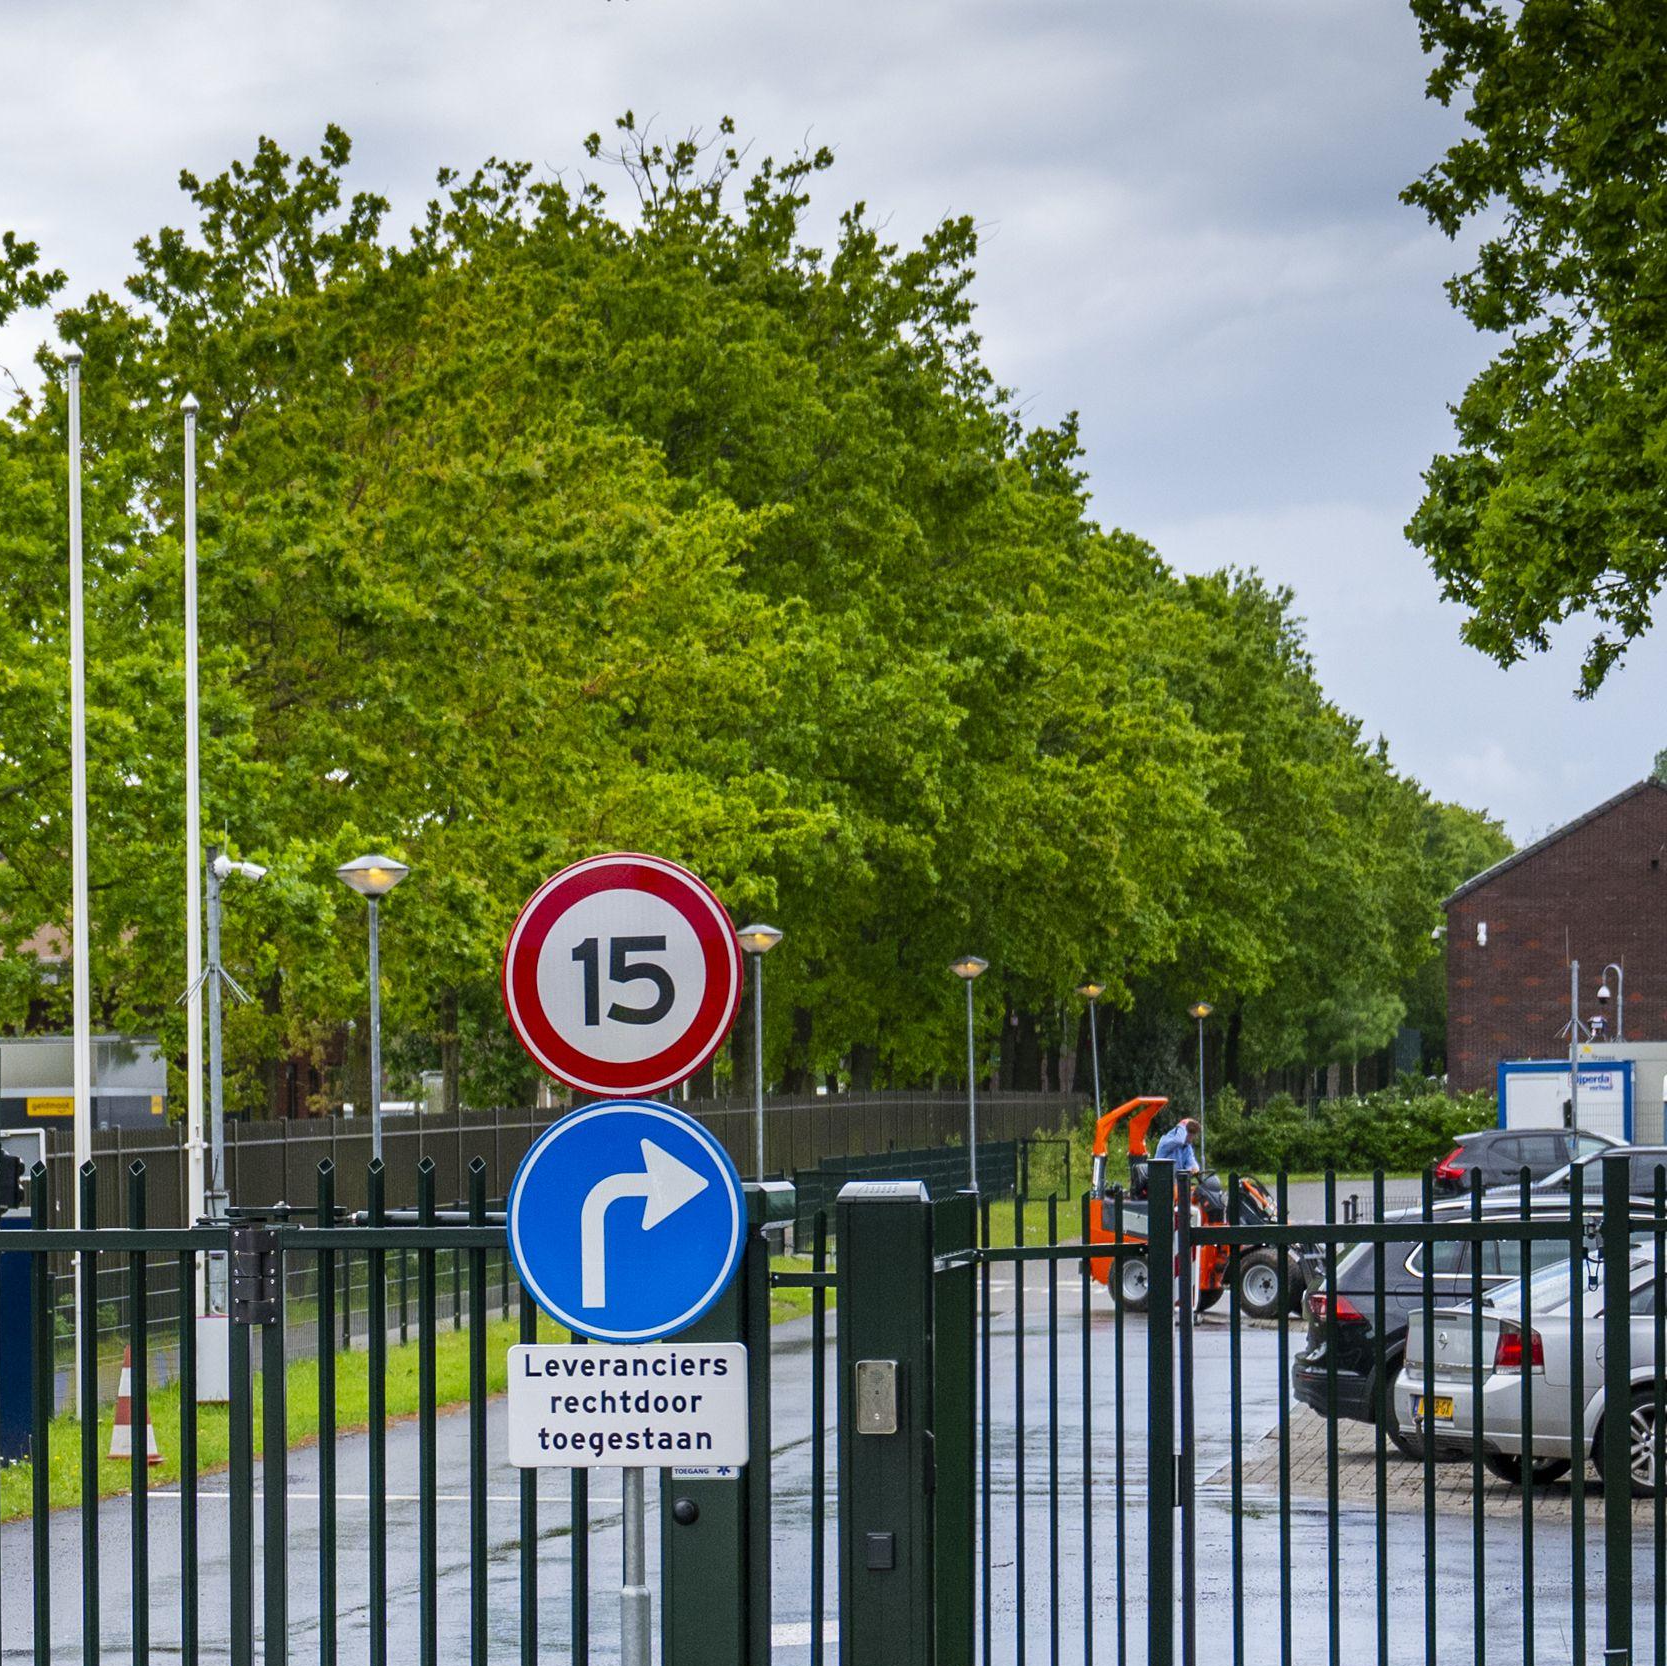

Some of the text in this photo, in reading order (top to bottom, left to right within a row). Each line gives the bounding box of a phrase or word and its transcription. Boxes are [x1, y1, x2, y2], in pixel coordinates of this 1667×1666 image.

[571, 934, 676, 1026] 15
[525, 1353, 728, 1377] Leveranciers
[550, 1389, 703, 1414] rechtdoor
[538, 1427, 712, 1457] toegestaan
[674, 1467, 709, 1475] TOEGANG
